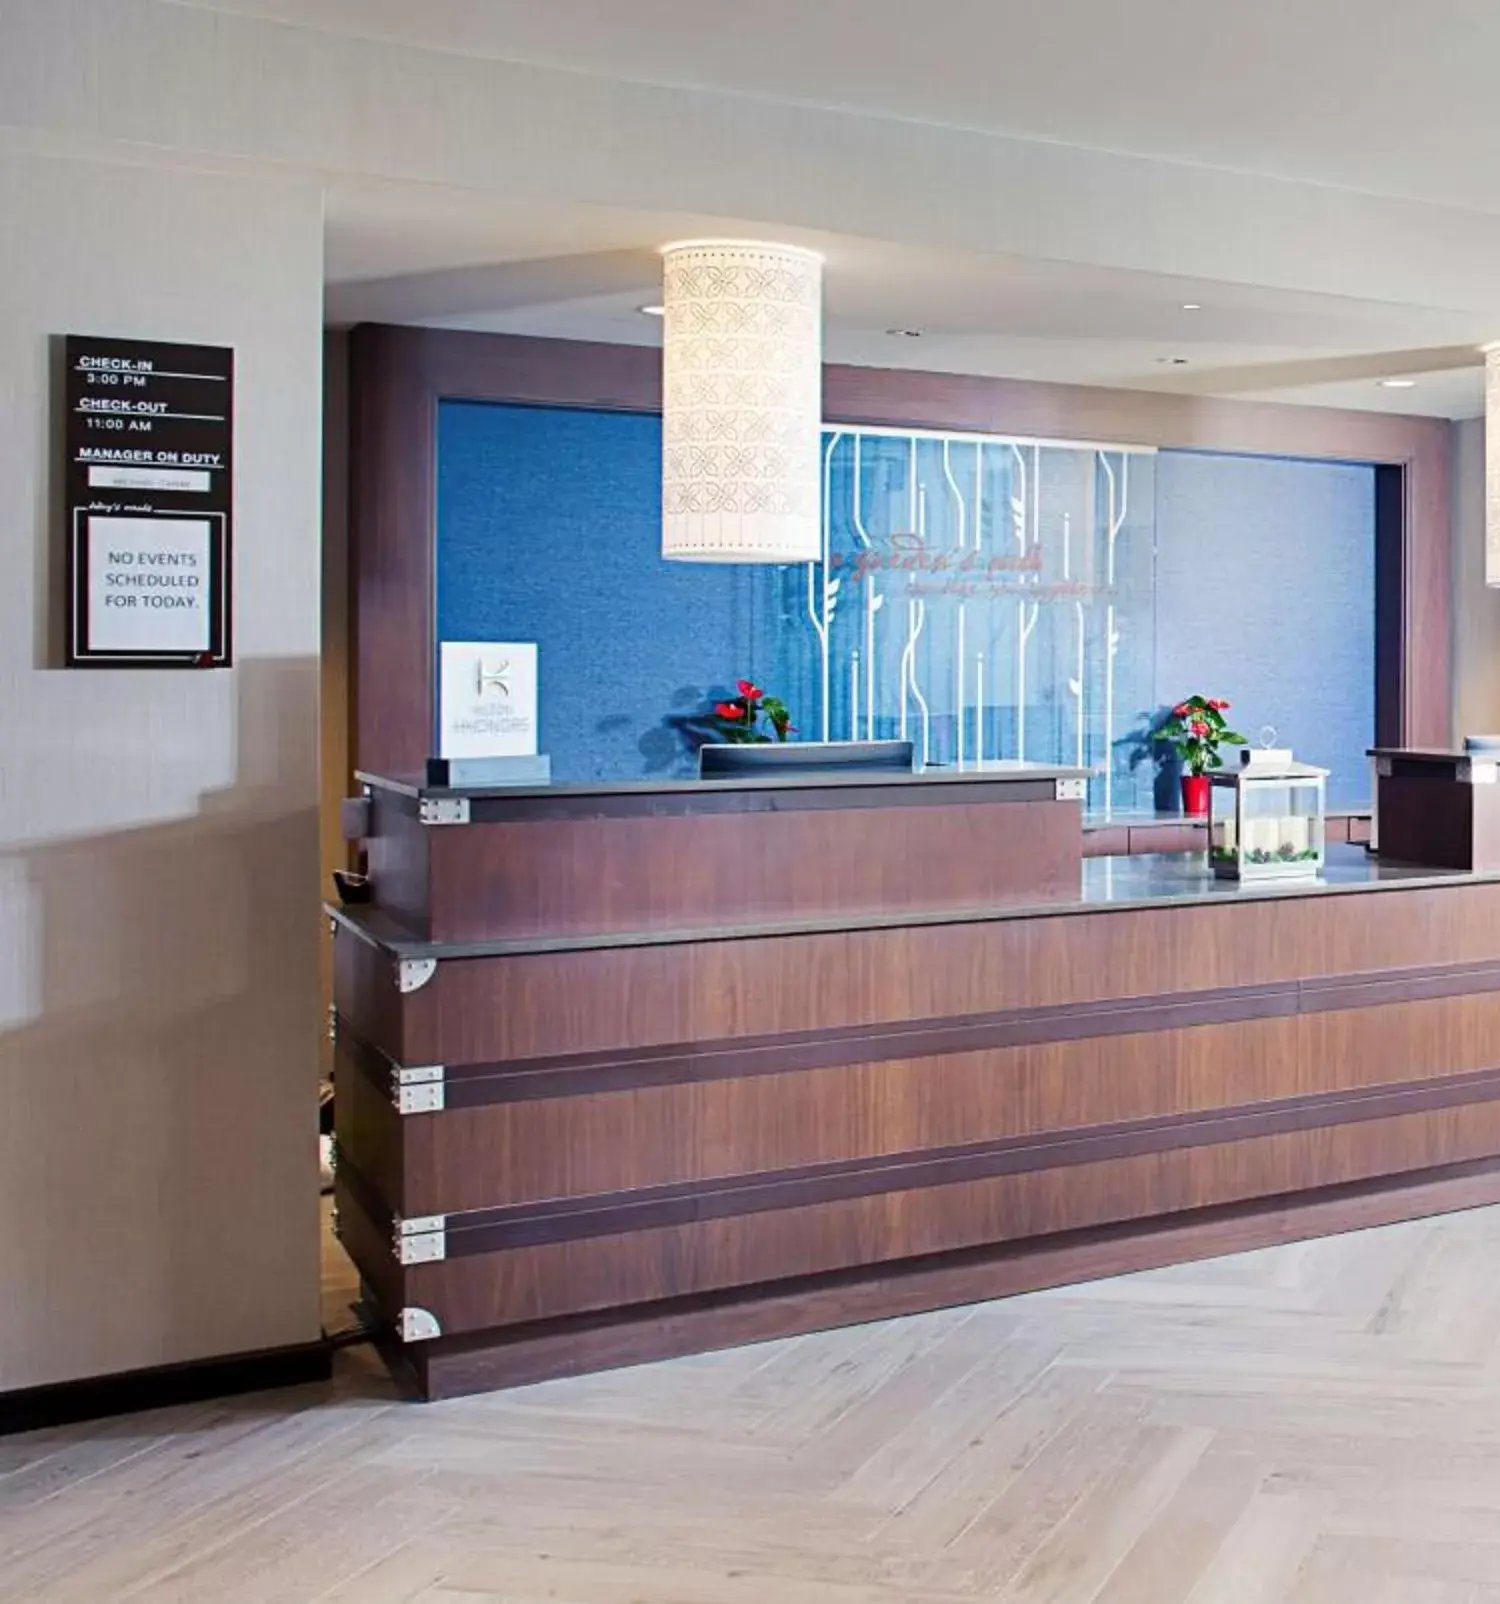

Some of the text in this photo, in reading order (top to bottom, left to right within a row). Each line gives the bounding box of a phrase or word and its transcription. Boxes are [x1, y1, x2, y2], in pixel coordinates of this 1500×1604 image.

[79, 355, 153, 371] CHECK-IN
[87, 373, 146, 387] 3:00 PM
[79, 397, 168, 413] CHECK-OUT
[86, 418, 151, 431] 11:00 AM
[79, 447, 220, 464] MANAGER ON DUTY
[108, 551, 197, 566] NO EVENTS
[105, 573, 199, 587] SCHEDULED
[104, 595, 200, 609] FOR TODAY.
